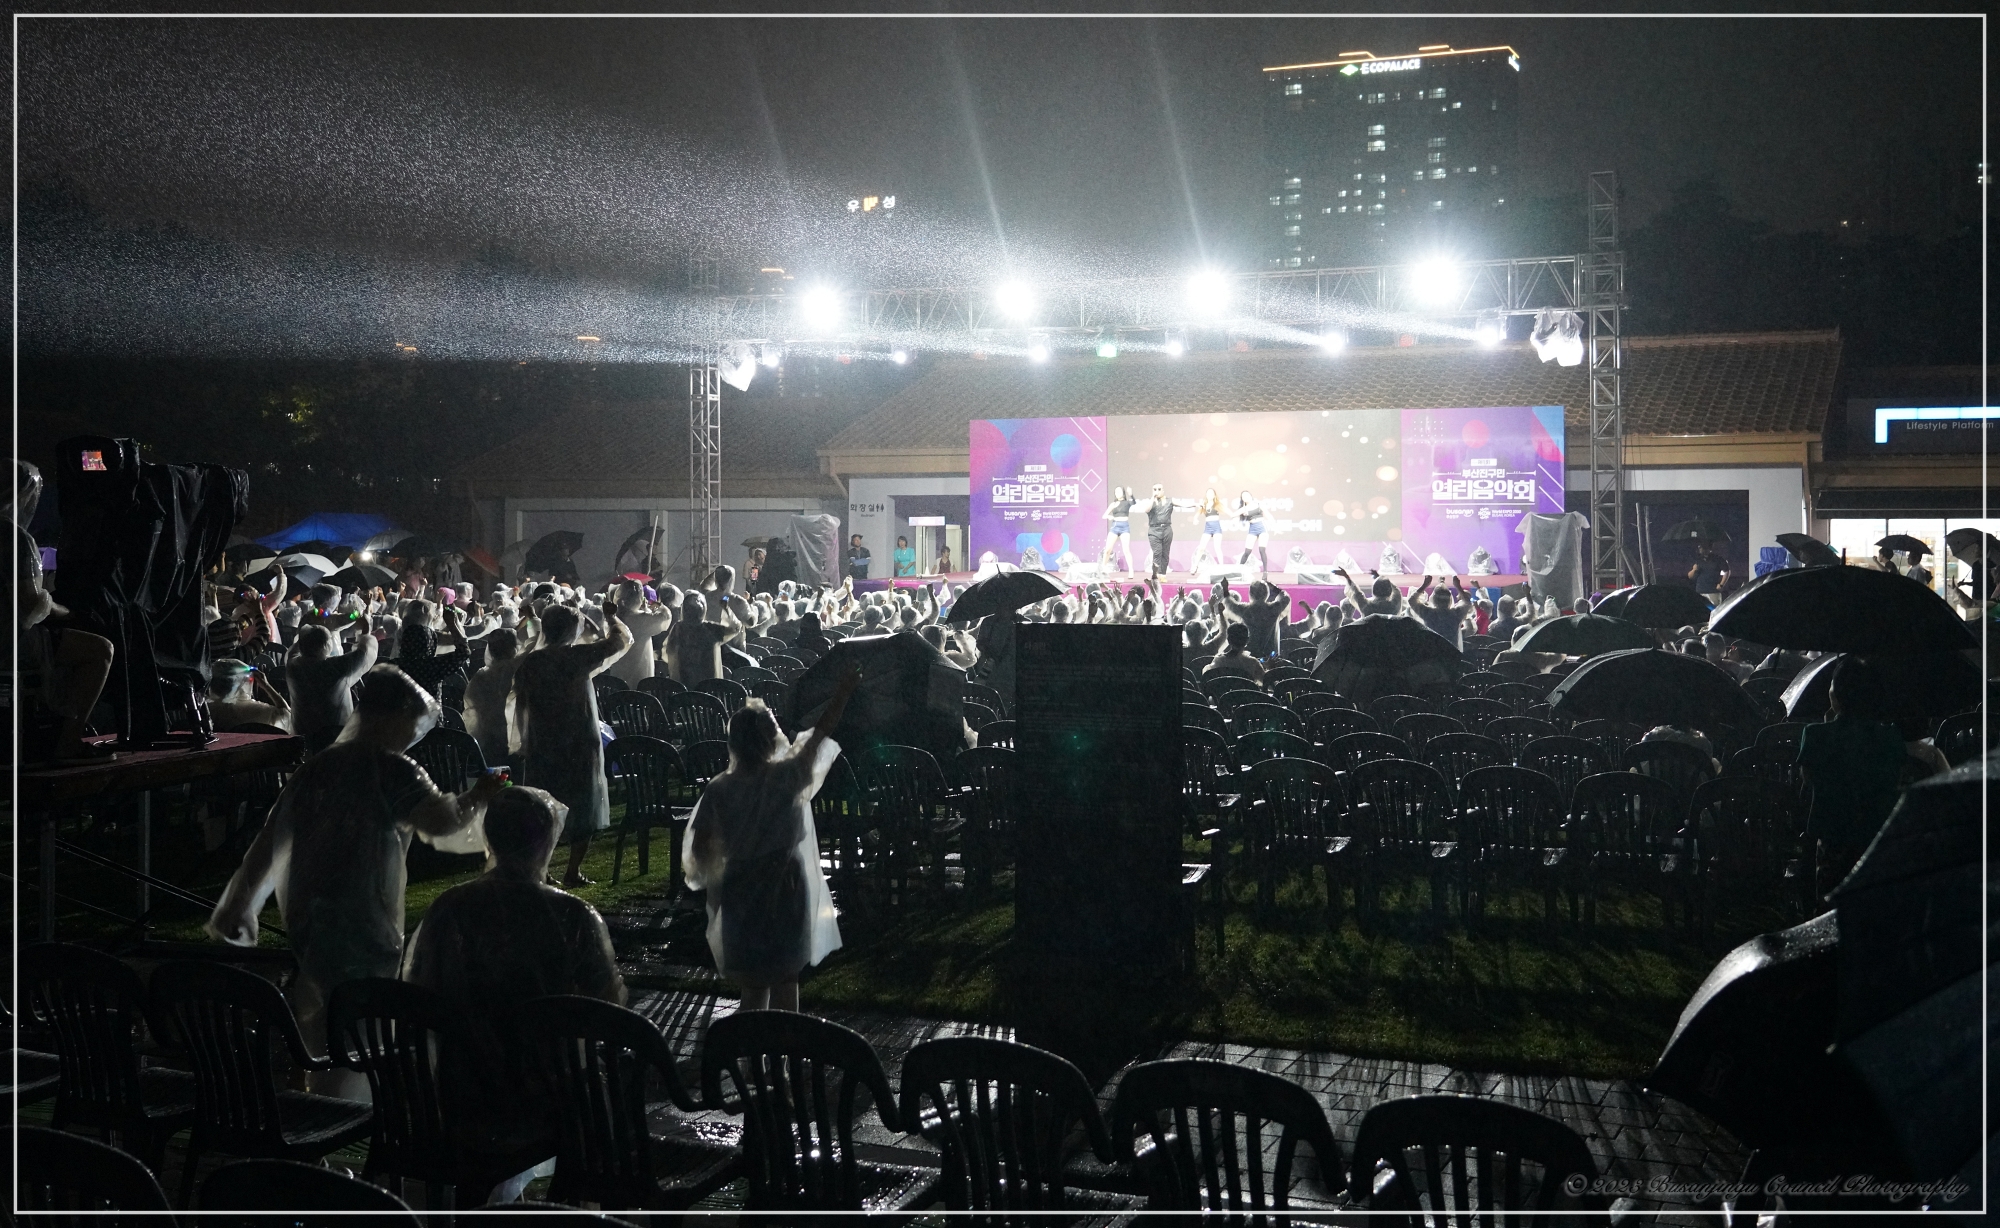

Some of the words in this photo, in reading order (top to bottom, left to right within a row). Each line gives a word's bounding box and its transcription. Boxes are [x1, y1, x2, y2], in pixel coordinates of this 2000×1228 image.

[1906, 421, 1948, 431] Lifestyle
[1462, 468, 1505, 478] 부산진구민
[1017, 474, 1054, 483] 부산진구민
[992, 484, 1079, 504] 열린음악회
[1432, 479, 1535, 502] 열린음악회
